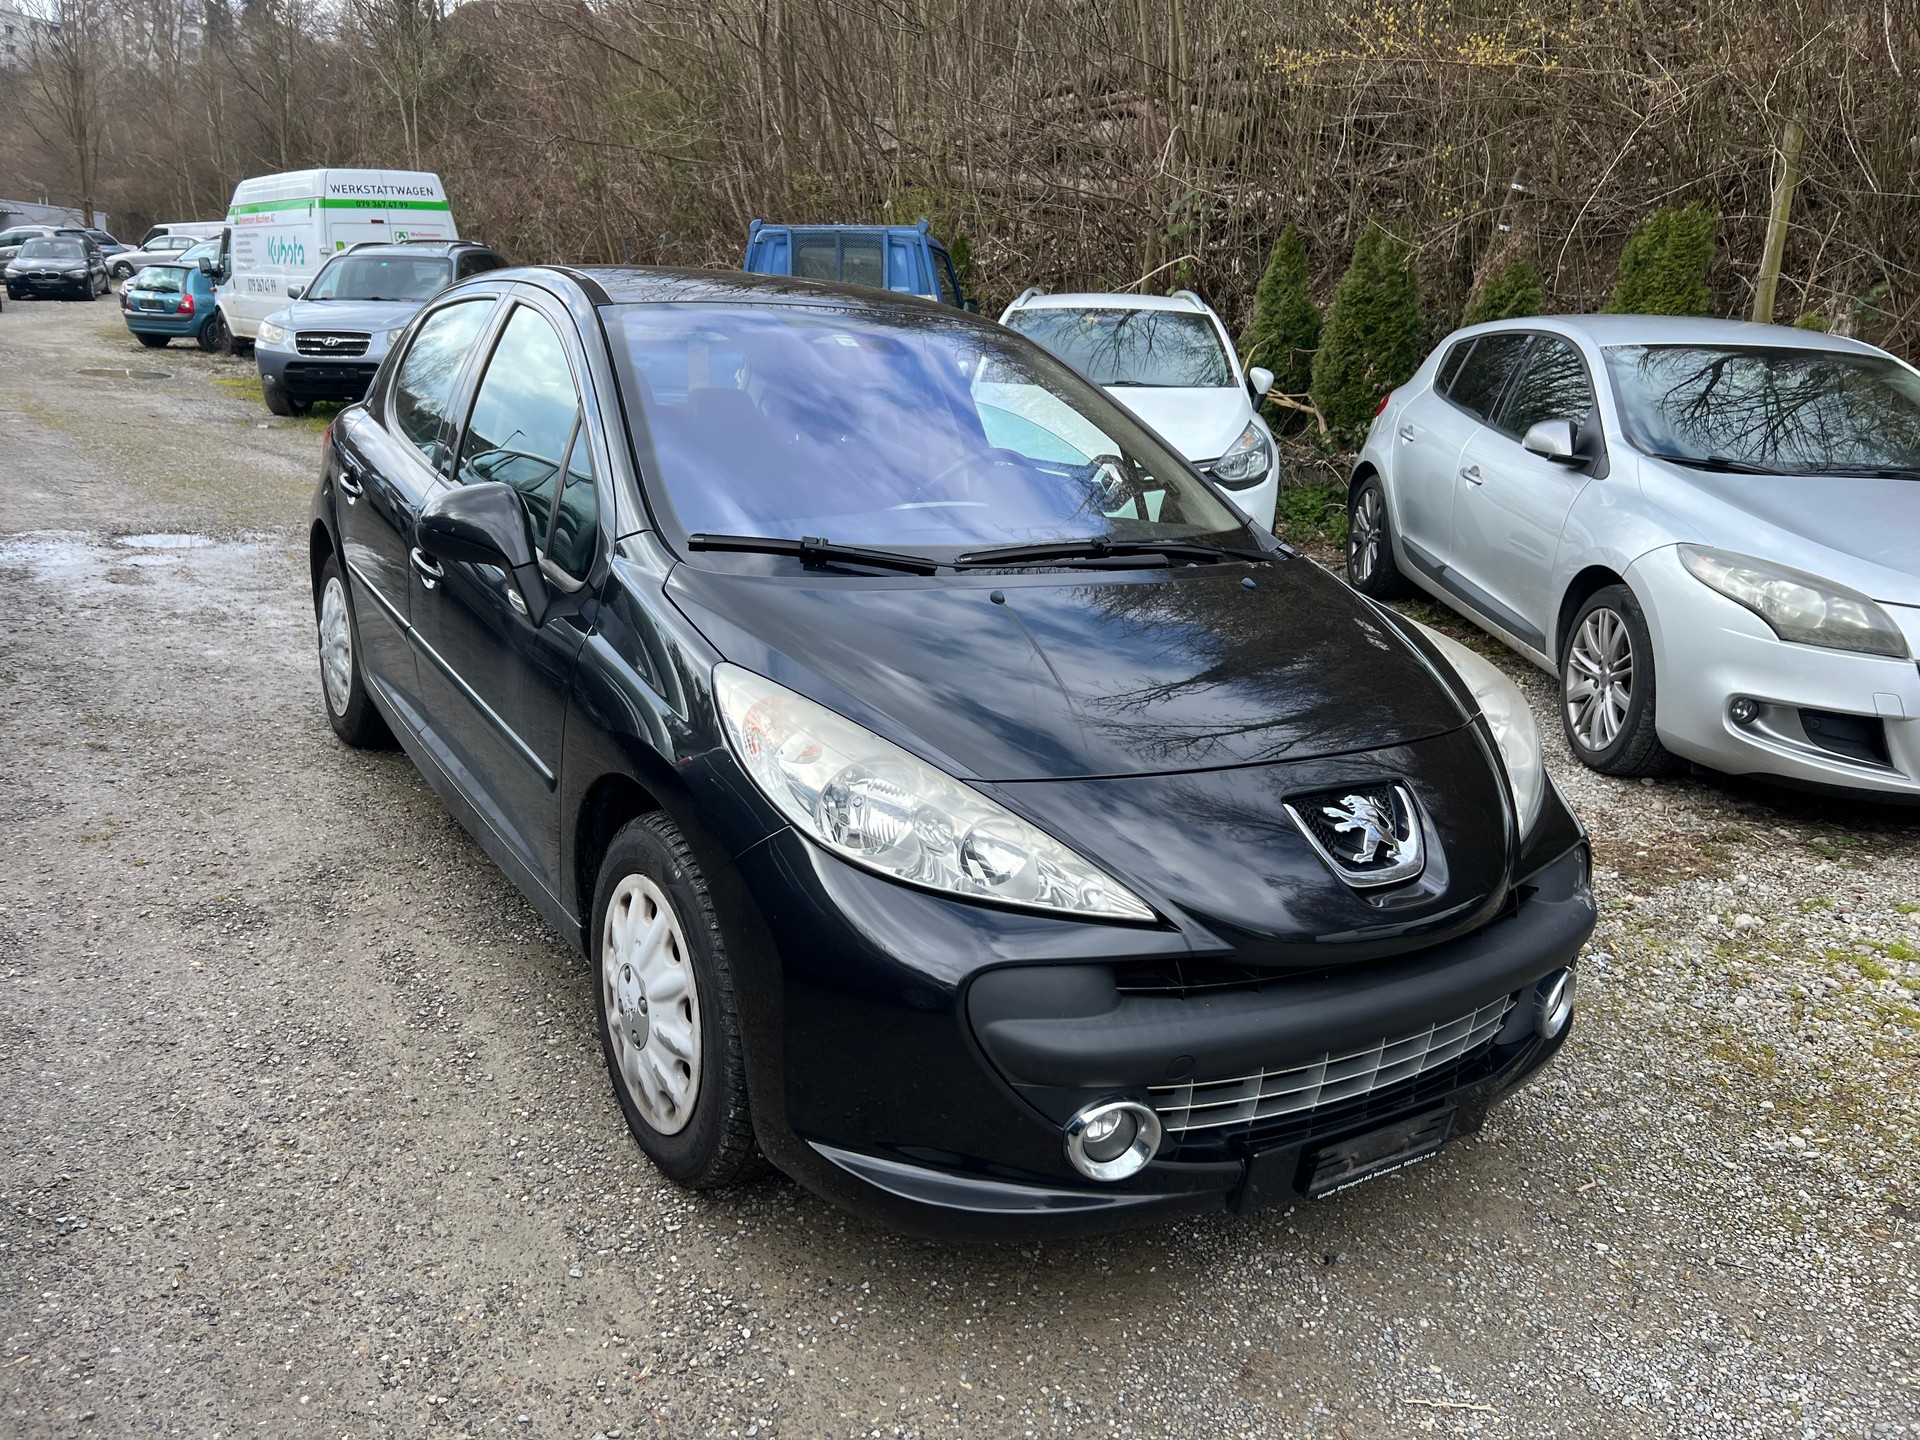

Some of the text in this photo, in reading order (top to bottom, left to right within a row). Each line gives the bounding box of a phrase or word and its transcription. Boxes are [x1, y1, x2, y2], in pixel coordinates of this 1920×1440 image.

[330, 184, 434, 197] WERKSTATTWAGEN
[355, 200, 370, 208] 079
[372, 200, 386, 208] 367
[268, 235, 305, 265] Kubota
[1317, 1188, 1336, 1200] Garage
[1336, 1177, 1364, 1191] Rheingold
[1364, 1173, 1372, 1181] AG
[1373, 1164, 1402, 1178] Neuhausen
